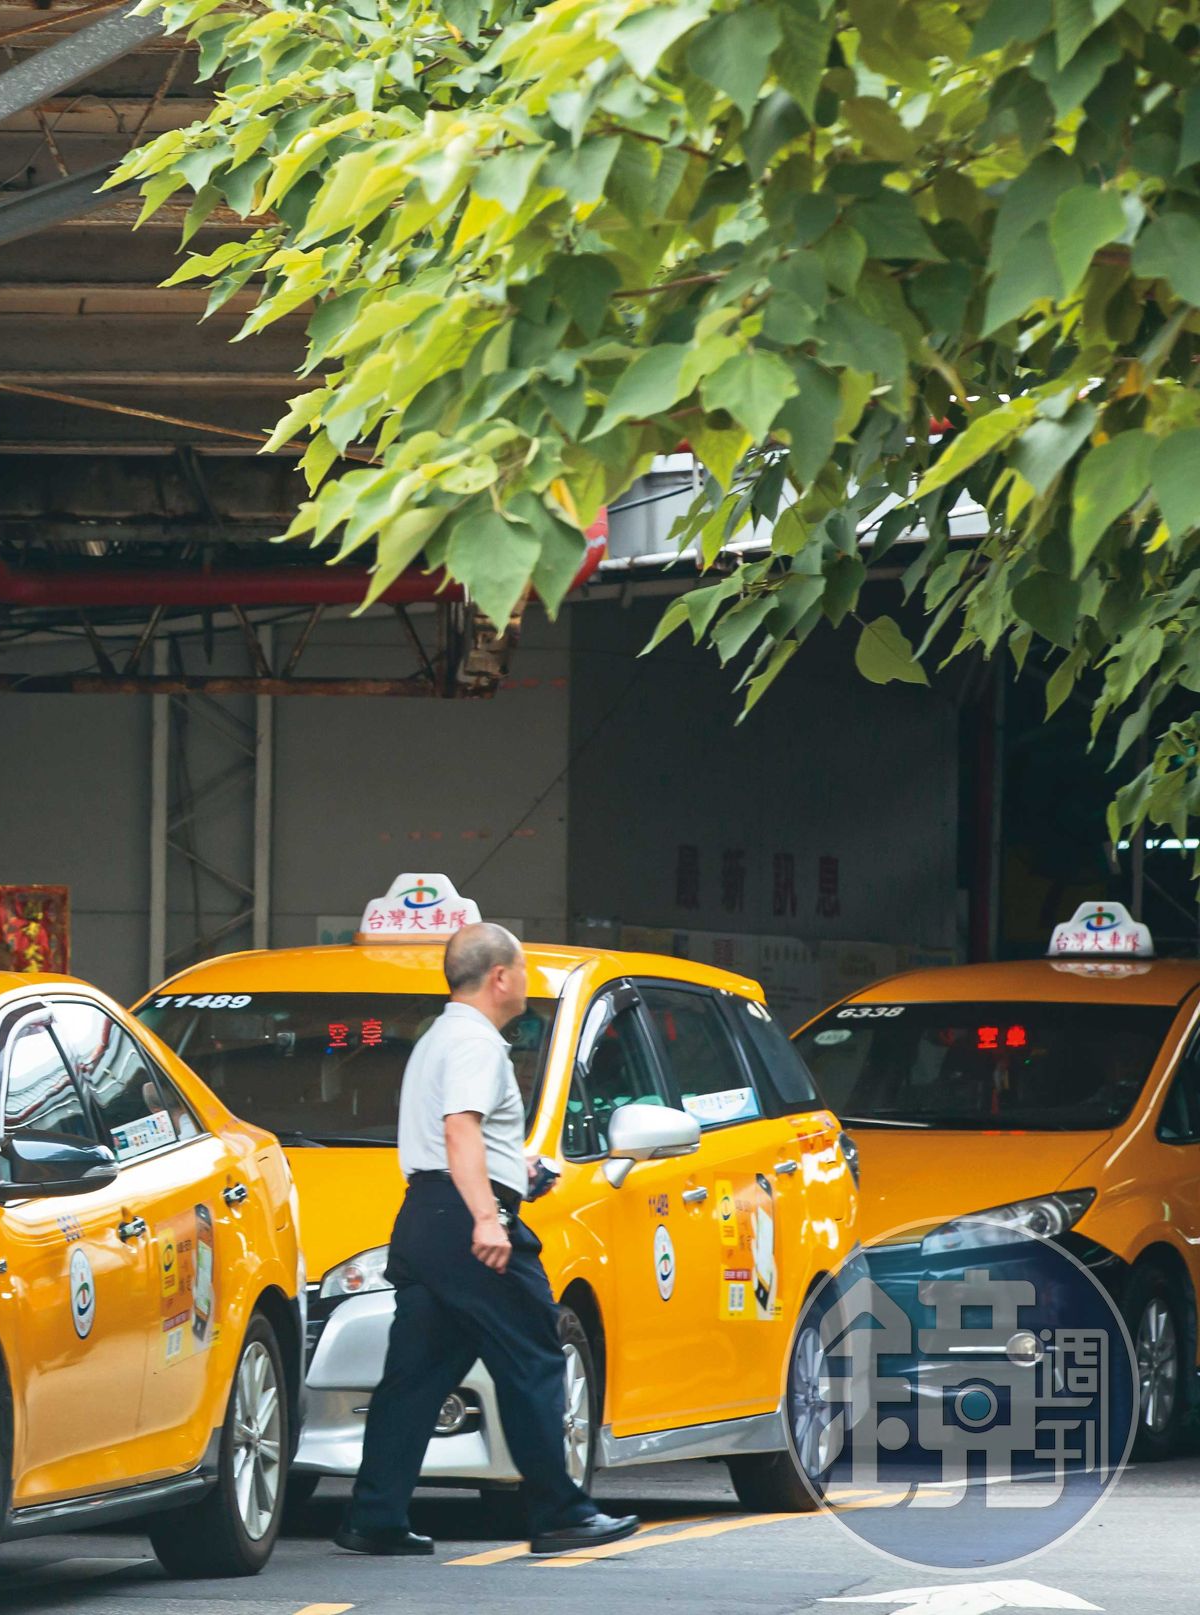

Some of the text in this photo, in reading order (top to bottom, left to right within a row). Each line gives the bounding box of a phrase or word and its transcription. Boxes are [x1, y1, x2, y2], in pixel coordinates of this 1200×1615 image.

[367, 908, 468, 930] 台灣大車隊
[1055, 931, 1141, 951] 台灣大車隊
[154, 995, 253, 1009] 11489
[836, 1006, 906, 1019] 6338
